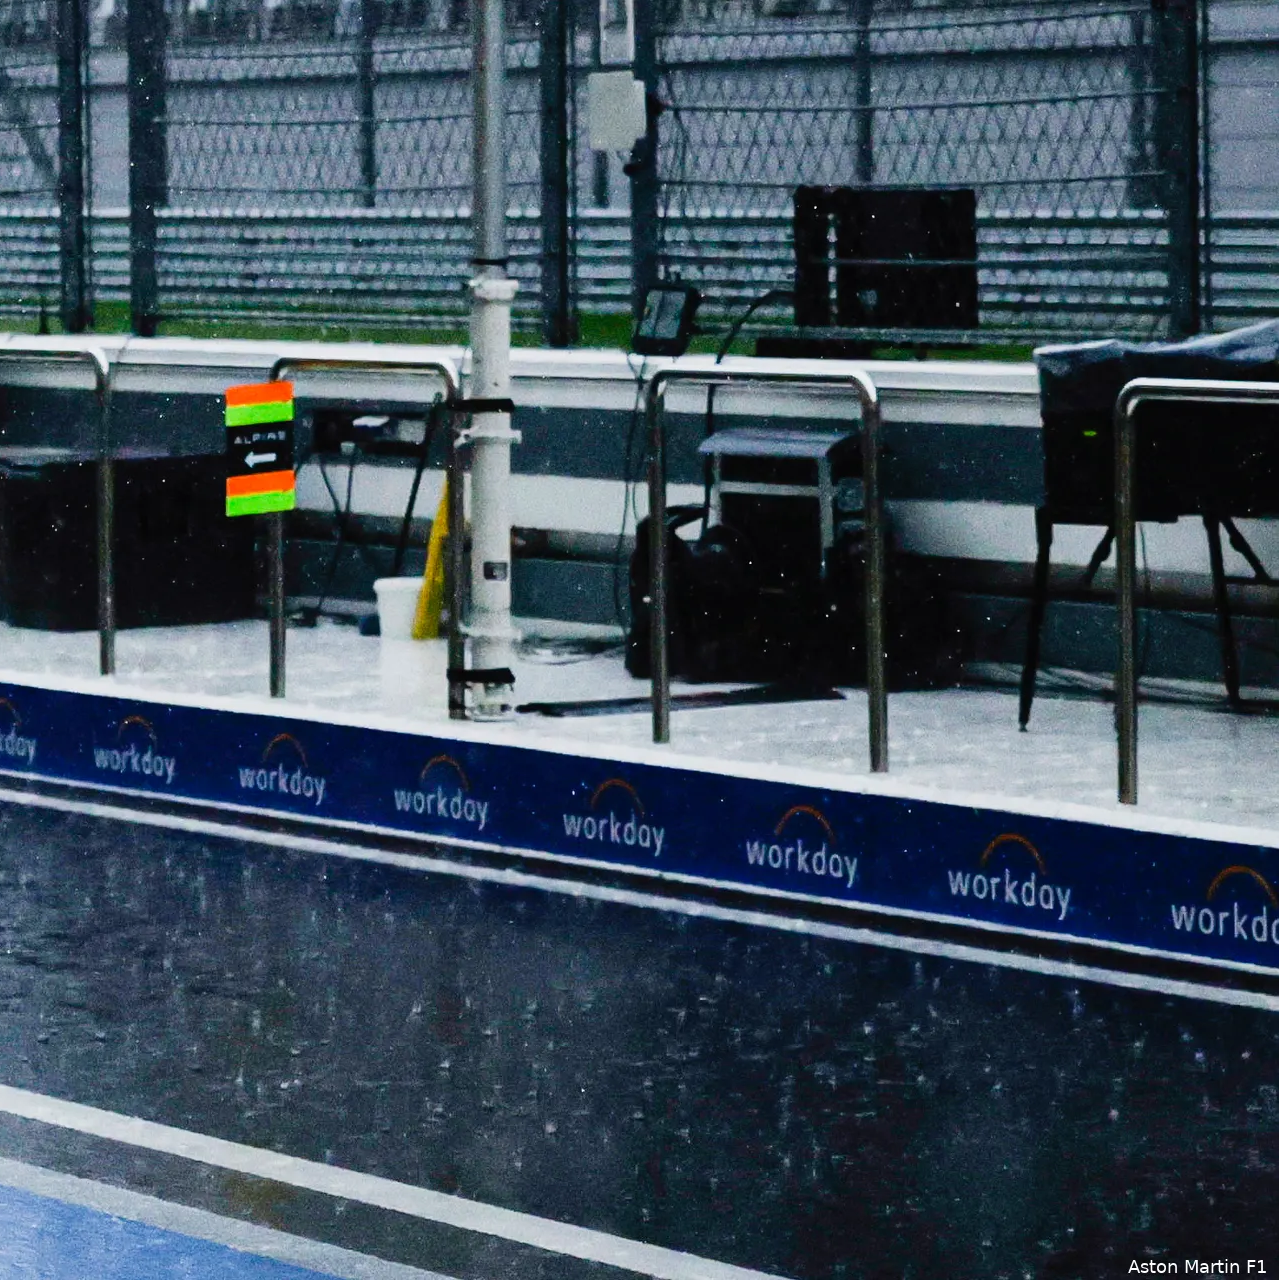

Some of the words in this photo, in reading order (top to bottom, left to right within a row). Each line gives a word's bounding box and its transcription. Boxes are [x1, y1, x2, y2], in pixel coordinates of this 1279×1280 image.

[93, 743, 175, 785] workday
[238, 760, 326, 806] workday
[393, 784, 489, 831] workday
[562, 808, 666, 858] workday
[745, 832, 859, 889] workday
[948, 863, 1072, 920] workday
